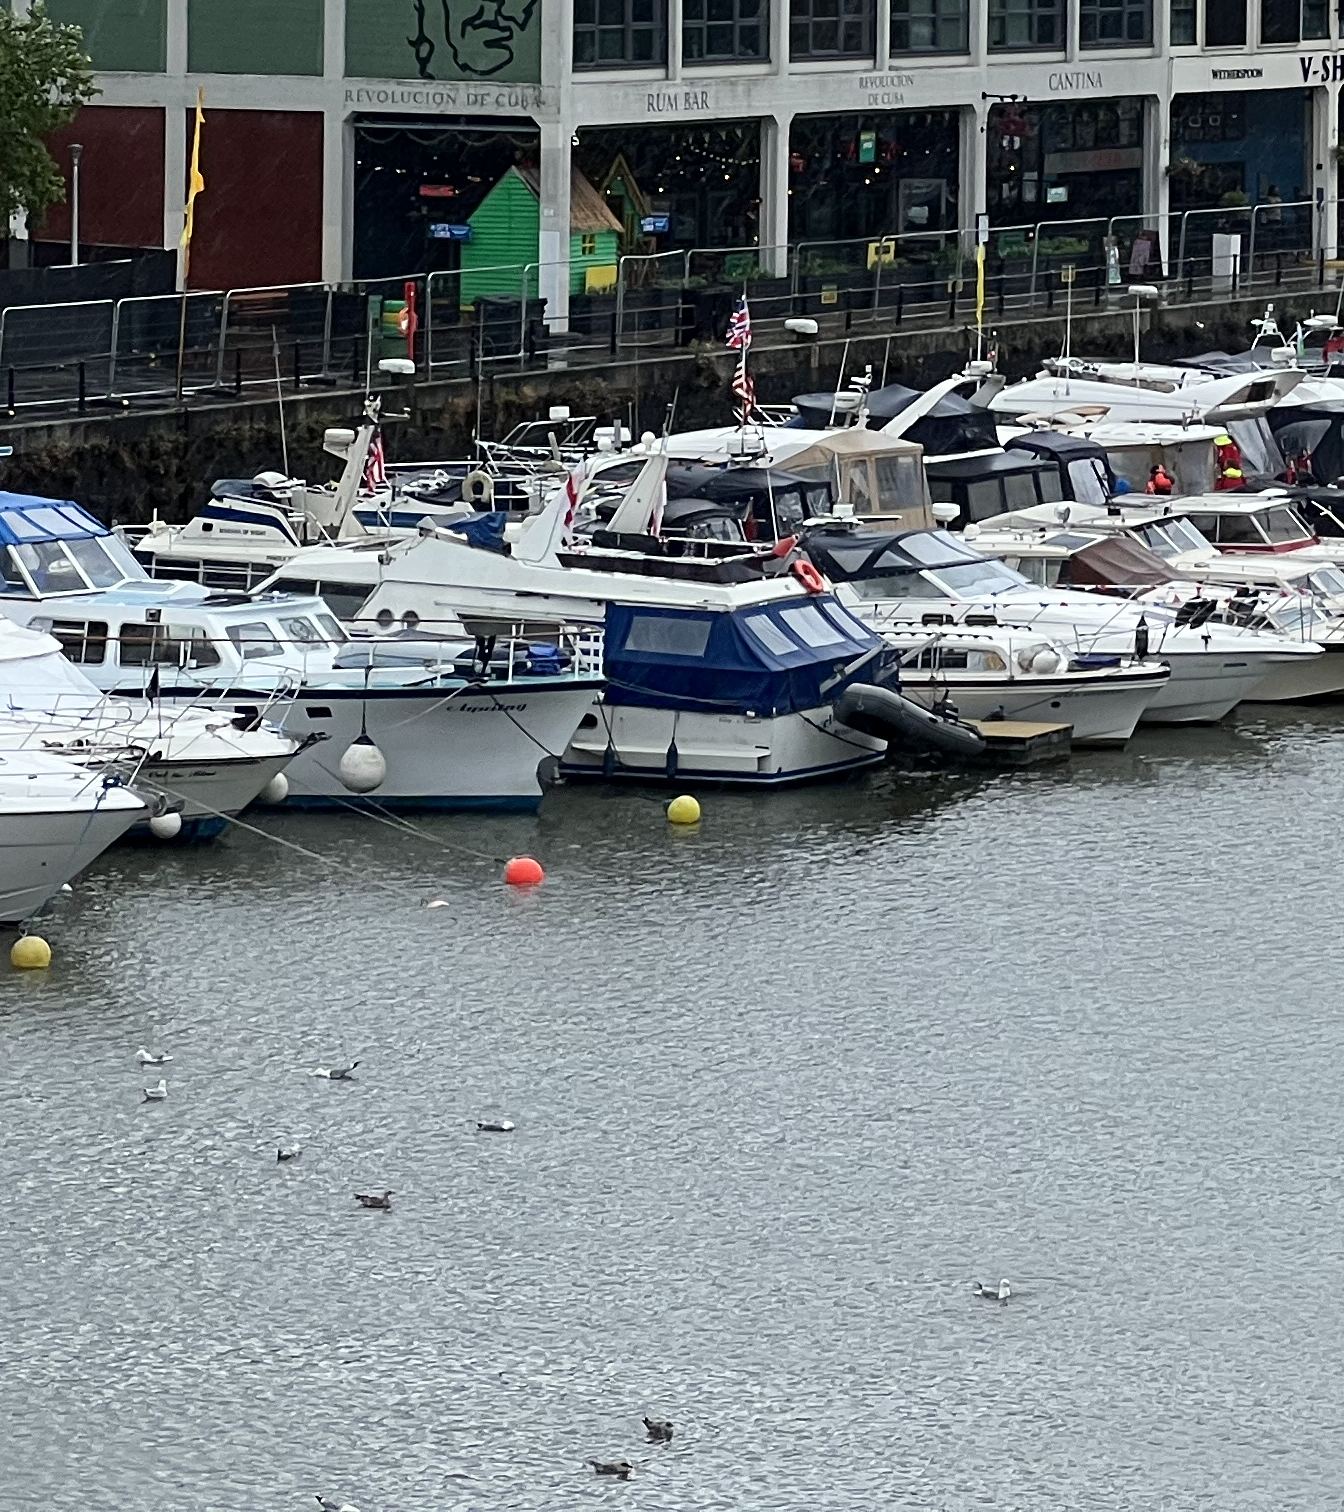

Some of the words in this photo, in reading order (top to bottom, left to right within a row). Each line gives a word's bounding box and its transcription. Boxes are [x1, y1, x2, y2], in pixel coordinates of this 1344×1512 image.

[1048, 71, 1103, 91] CANTINA
[344, 89, 457, 106] REVOLUCION
[466, 92, 490, 106] DE
[647, 92, 679, 112] RUM
[684, 91, 710, 111] BAR
[867, 92, 881, 106] DE
